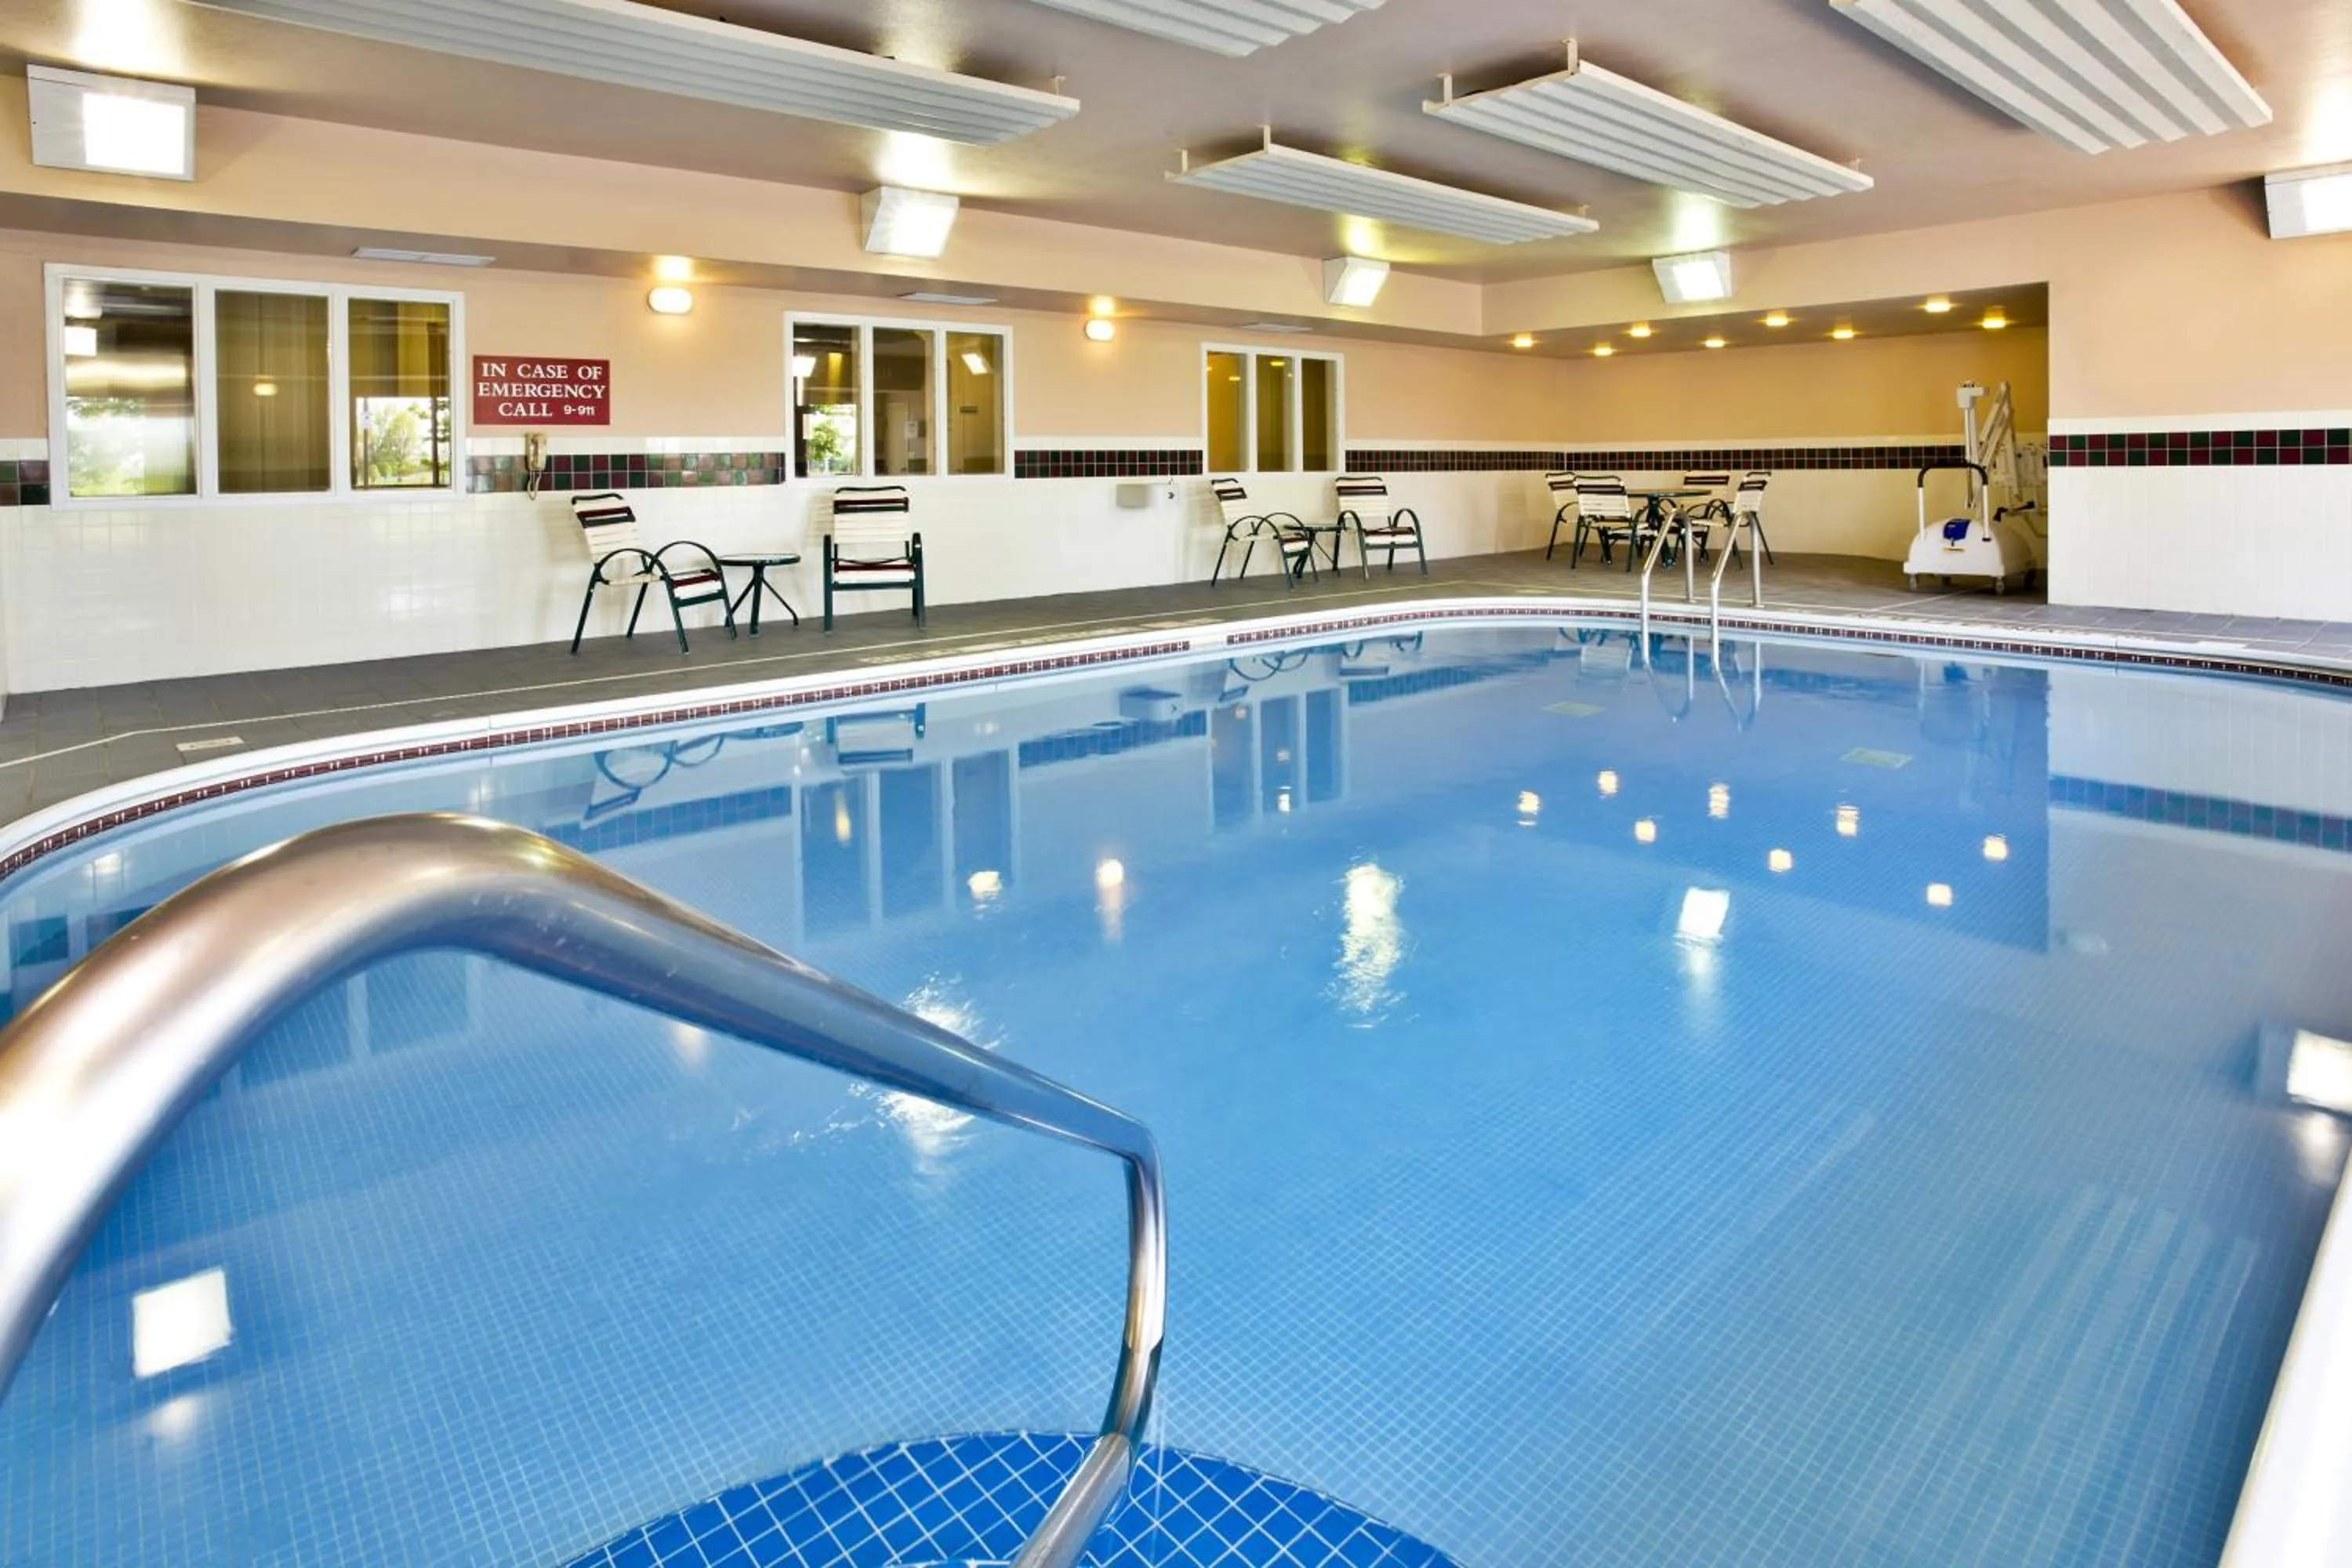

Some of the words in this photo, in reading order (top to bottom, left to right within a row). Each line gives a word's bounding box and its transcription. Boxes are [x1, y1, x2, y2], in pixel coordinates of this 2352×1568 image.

[481, 363, 507, 377] IN
[517, 364, 568, 379] CASE
[577, 365, 603, 380] OF
[477, 382, 606, 398] EMERGENCY
[498, 402, 553, 417] CALL
[564, 405, 595, 416] 9-911
